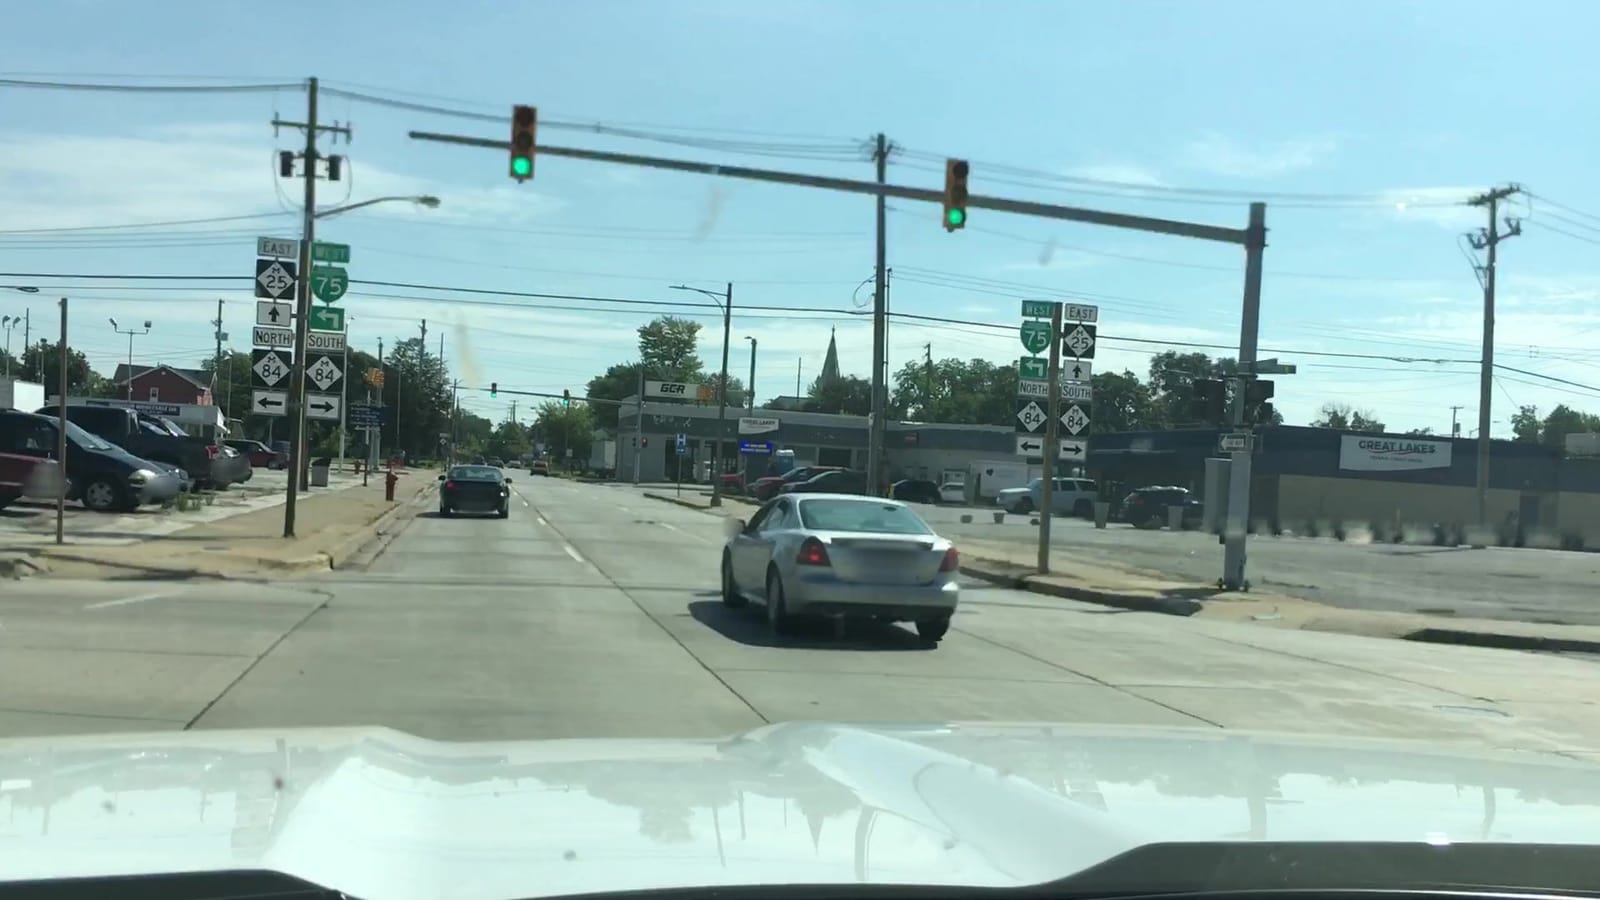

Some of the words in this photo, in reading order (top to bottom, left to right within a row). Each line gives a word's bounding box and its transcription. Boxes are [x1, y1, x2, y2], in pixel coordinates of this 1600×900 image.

[263, 240, 292, 254] EAST
[265, 274, 288, 290] 25
[316, 277, 342, 295] 75
[1025, 304, 1050, 316] WEST
[1069, 307, 1094, 319] EAST
[255, 330, 291, 346] NORTH
[308, 334, 344, 349] SOUTH
[1025, 331, 1047, 347] 75
[1071, 337, 1089, 350] 25
[261, 364, 282, 379] 84
[315, 368, 335, 382] 84
[660, 383, 686, 394] GCR
[1019, 382, 1048, 395] NORTH
[1062, 386, 1091, 399] SOUTH
[1024, 412, 1041, 424] 84
[1067, 415, 1084, 428] 84
[676, 433, 686, 446] H
[1358, 440, 1397, 451] GREAT
[1399, 442, 1436, 454] LAKES
